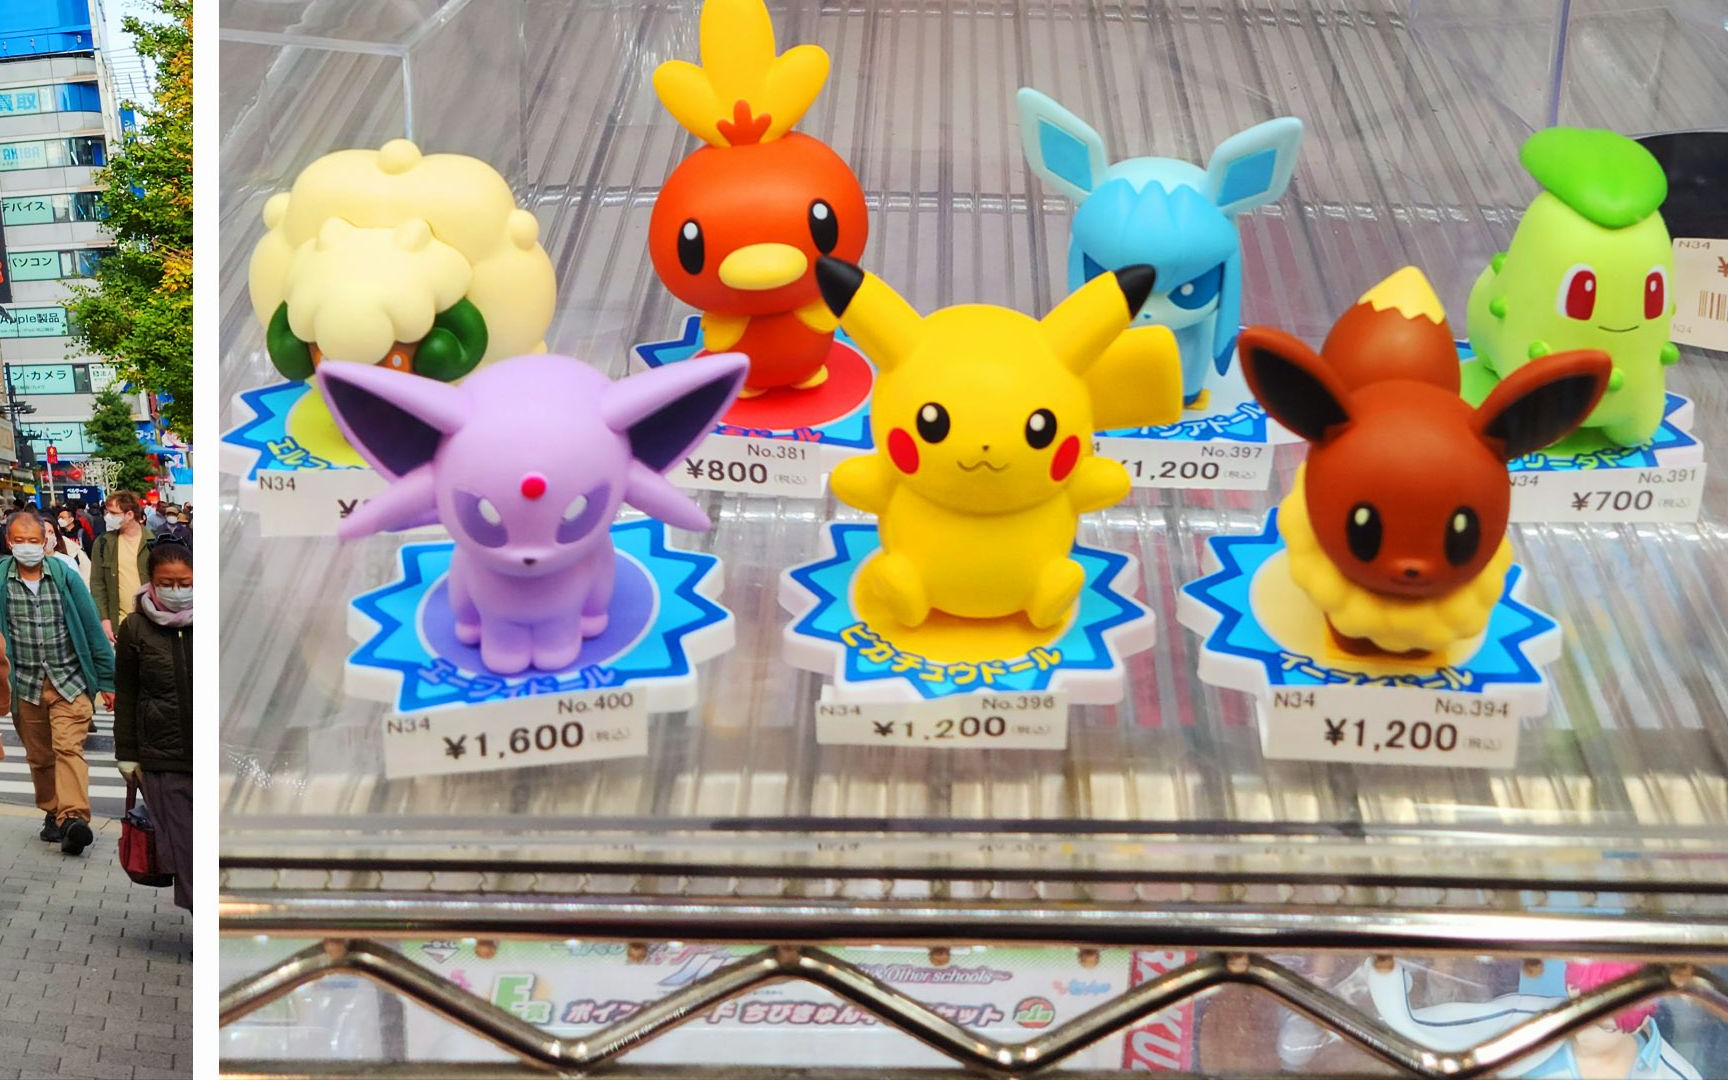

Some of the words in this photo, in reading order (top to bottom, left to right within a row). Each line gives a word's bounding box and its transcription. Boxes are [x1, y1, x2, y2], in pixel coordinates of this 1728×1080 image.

[1679, 240, 1711, 250] N34
[747, 443, 806, 461] No.381
[1201, 445, 1263, 459] No.397
[685, 457, 768, 484] ¥800
[1120, 460, 1220, 481] 1,200
[1638, 468, 1696, 485] No.391
[259, 476, 296, 491] N34
[1570, 489, 1654, 512] ¥700
[840, 623, 1062, 684] ピカチュウドール
[387, 716, 431, 734] N34
[557, 691, 634, 715] No.400
[820, 704, 862, 717] N34
[1273, 692, 1315, 708] N34
[1434, 697, 1509, 718] No.394
[873, 716, 1007, 740] ¥1,200
[1324, 718, 1458, 752] ¥1,200
[442, 721, 584, 760] ¥1,600
